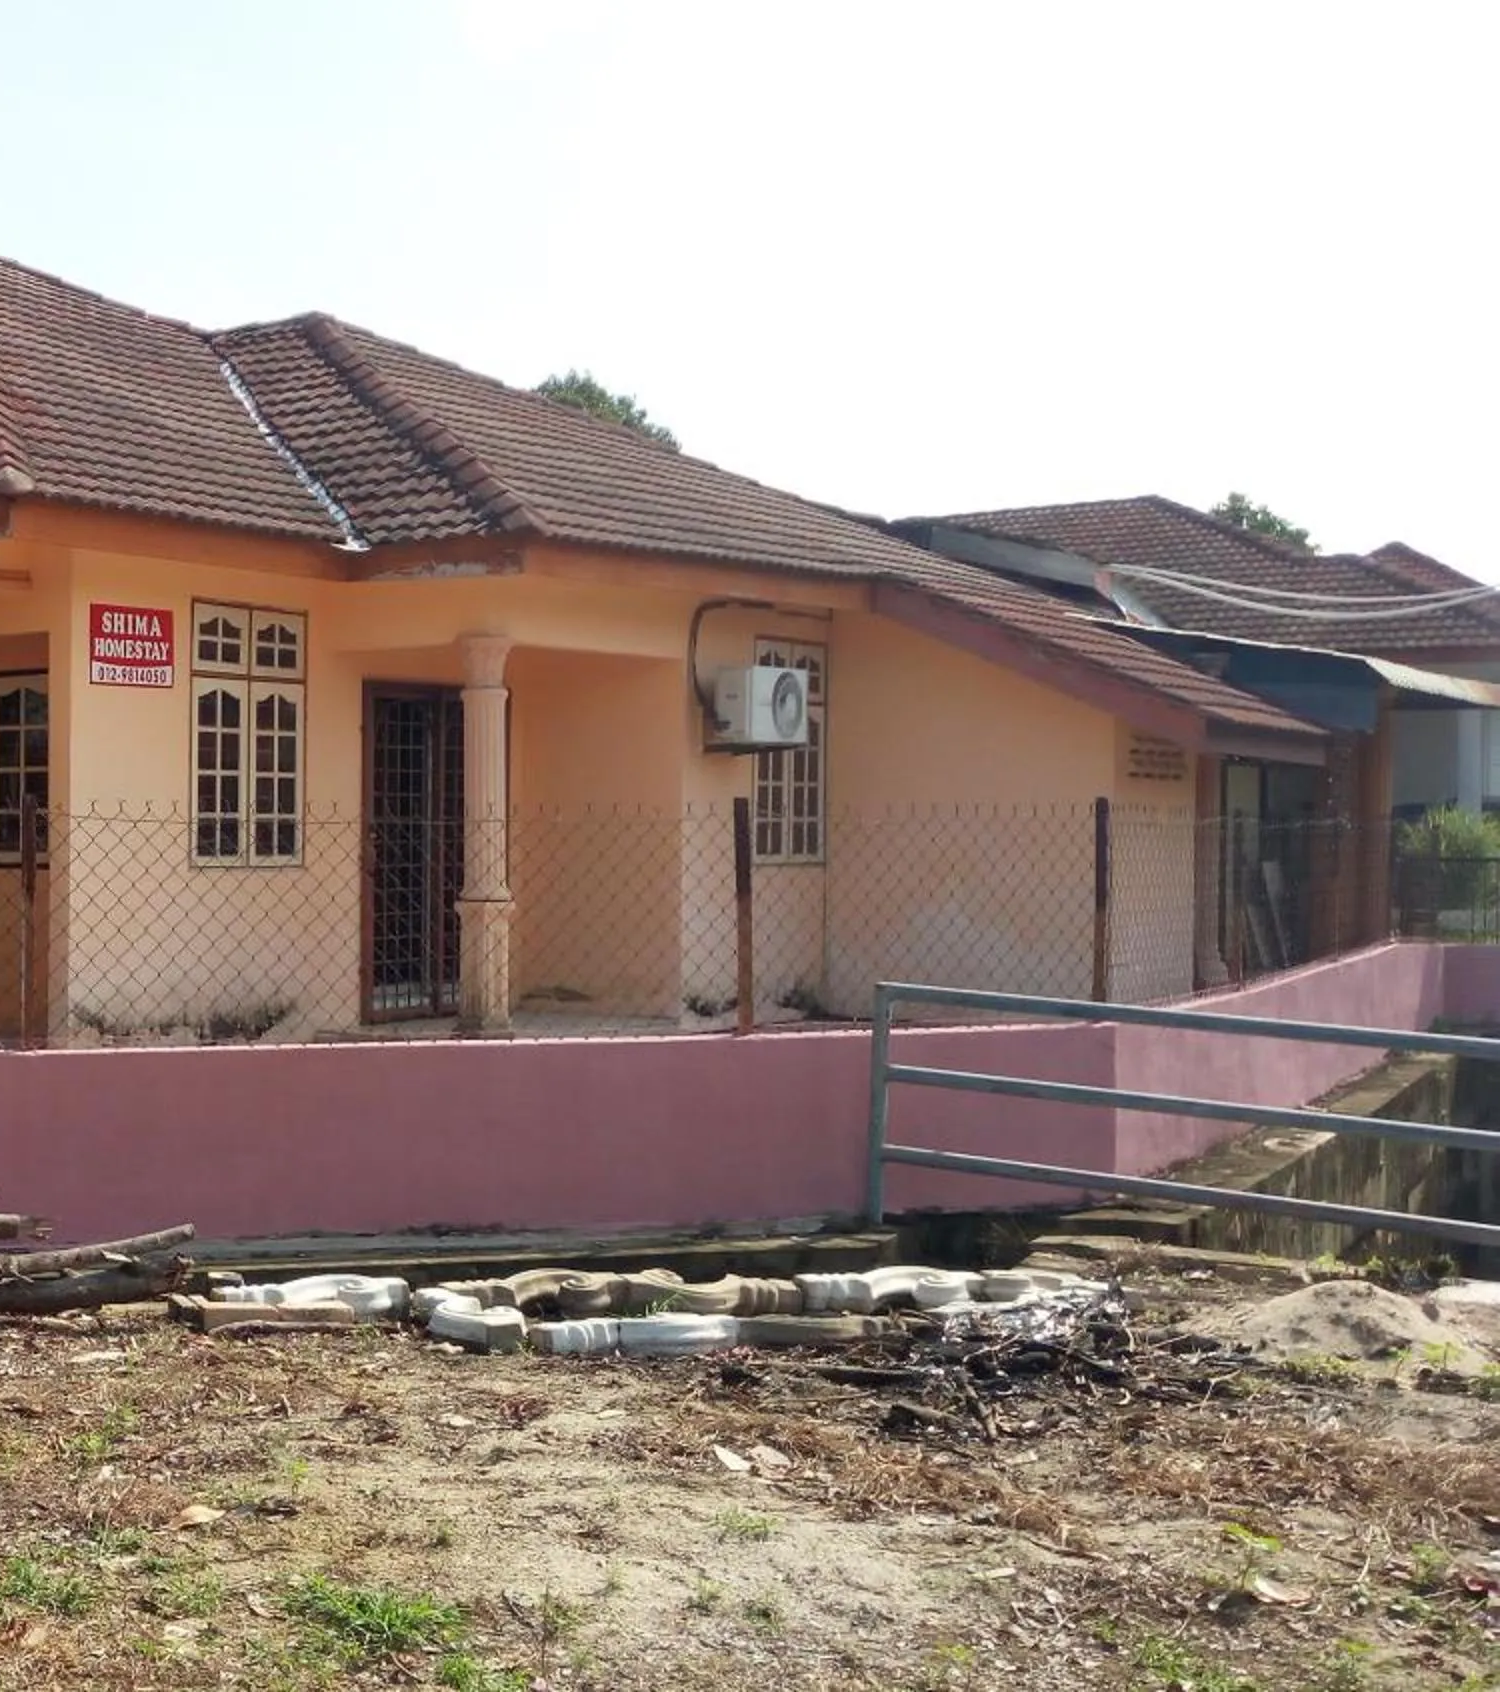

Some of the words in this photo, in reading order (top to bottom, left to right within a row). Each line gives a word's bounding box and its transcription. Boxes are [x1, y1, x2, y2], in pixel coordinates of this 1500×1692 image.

[101, 611, 162, 637] SHIMA
[94, 637, 169, 661] HOMESTAY
[97, 665, 167, 683] 012-9814050
